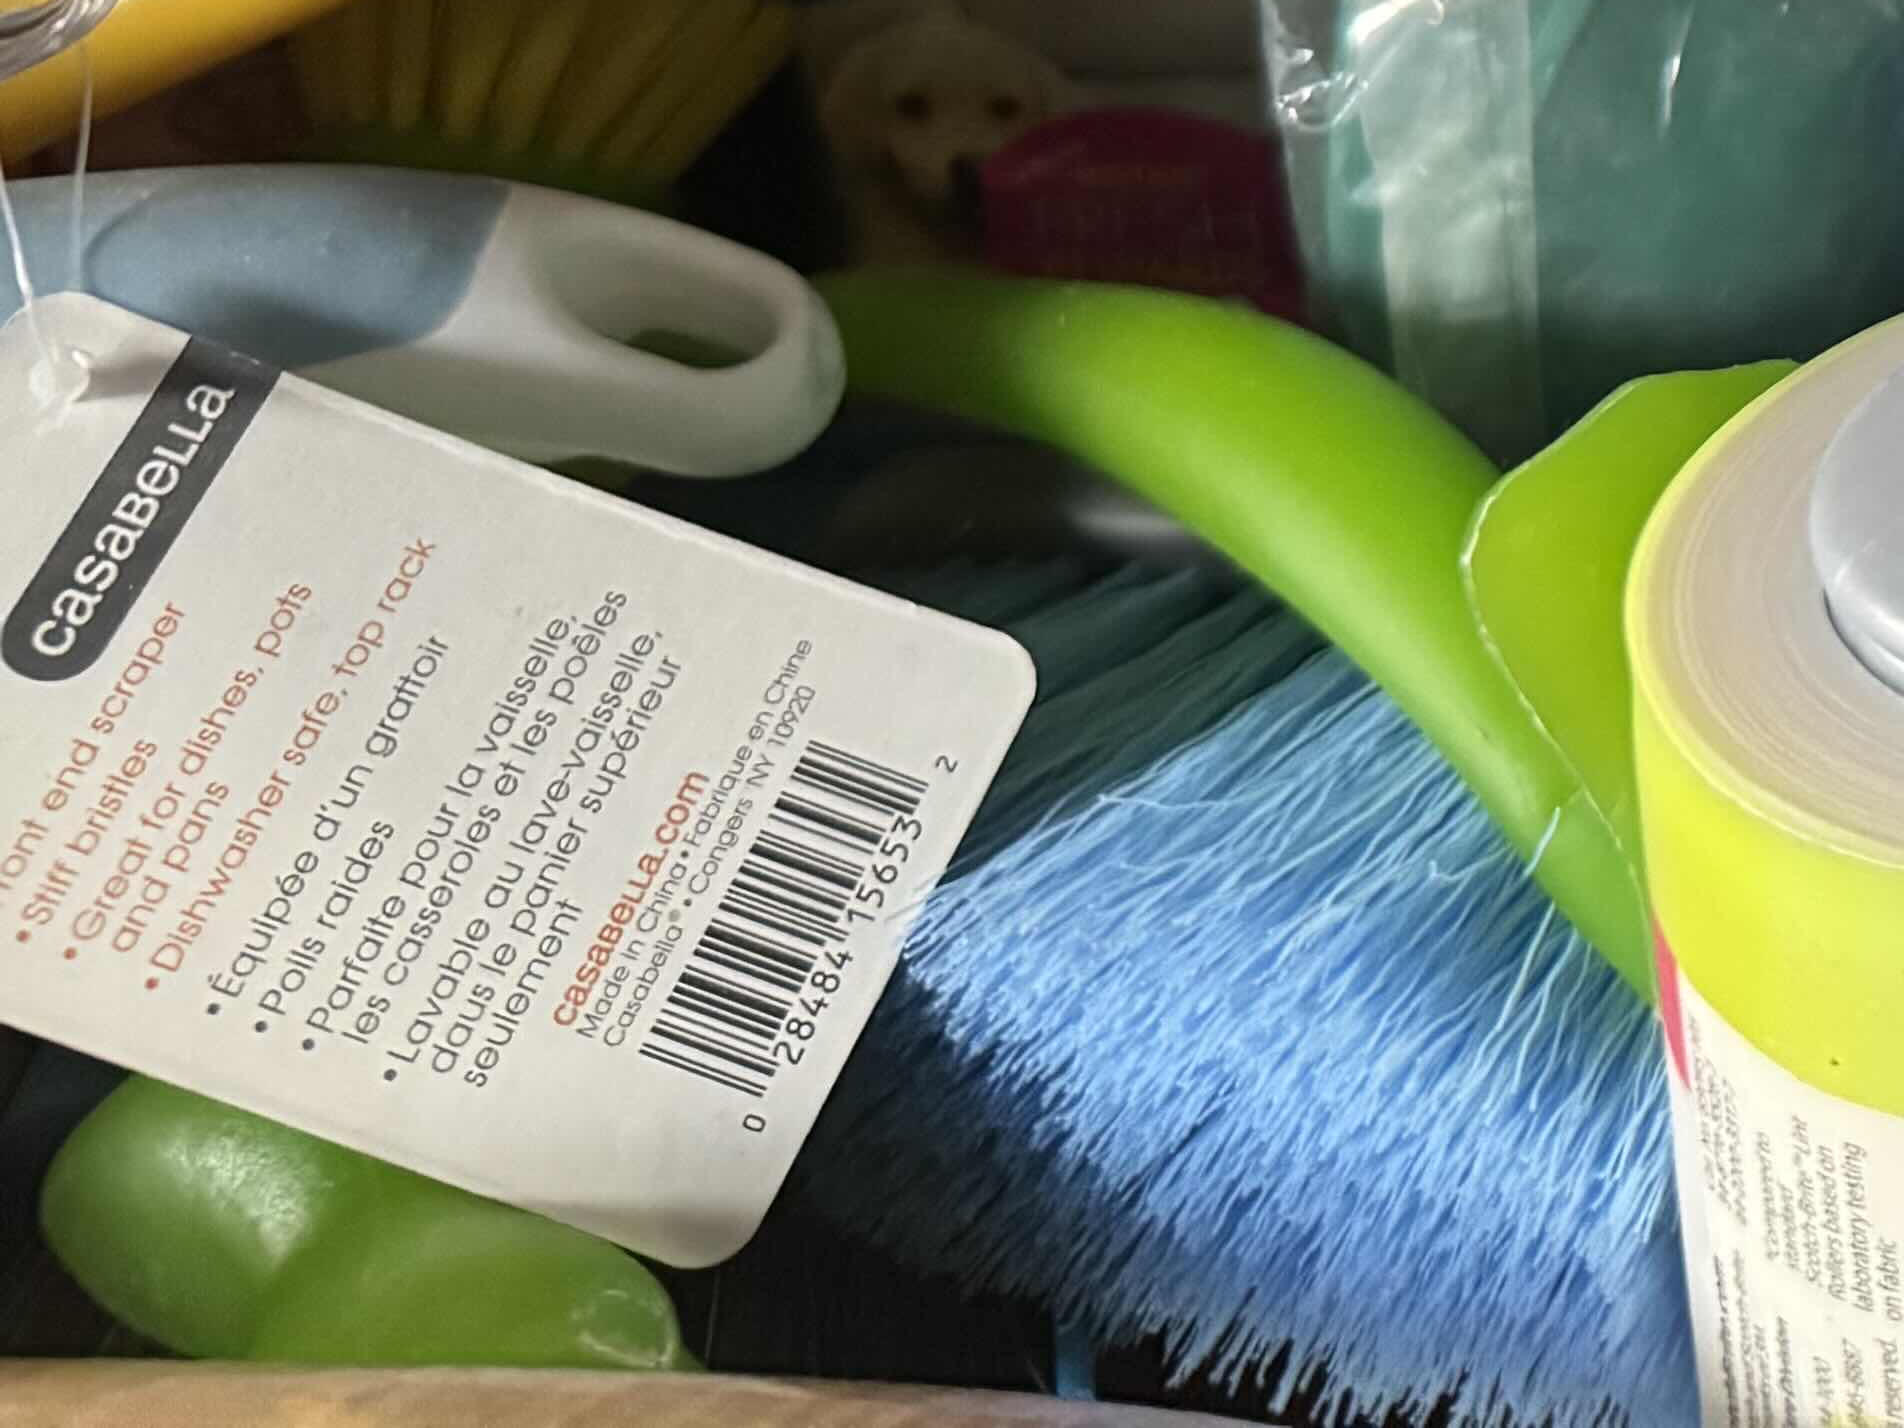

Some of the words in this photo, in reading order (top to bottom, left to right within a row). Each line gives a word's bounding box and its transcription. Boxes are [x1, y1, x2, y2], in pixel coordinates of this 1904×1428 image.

[41, 737, 101, 812] end
[90, 601, 186, 735] scraper
[508, 709, 558, 757] les
[547, 590, 628, 706] poêles
[20, 859, 80, 926] Stiff
[63, 739, 158, 857] bristles
[71, 836, 153, 942] Great
[138, 781, 187, 831] for
[178, 666, 265, 777] dishes,
[252, 583, 313, 659] pots
[148, 769, 292, 973] Dishwasher
[282, 687, 349, 767] safe,
[330, 619, 385, 678] top
[375, 537, 438, 614] rack
[206, 850, 320, 999] Équipée
[364, 634, 449, 759] grattoir
[304, 895, 407, 1034] Parfaite
[397, 802, 460, 891] pour
[443, 762, 487, 798] la
[473, 615, 585, 753] vaisselle,
[385, 917, 491, 1064] Lavable
[483, 860, 526, 910] au
[508, 630, 664, 855] lave-vaisselle,
[477, 942, 518, 977] le
[508, 816, 589, 938] panier
[578, 655, 682, 815] supérieur
[493, 760, 527, 798] et
[575, 965, 631, 1039] Made
[635, 861, 688, 934] China
[674, 744, 766, 848] Fabrique
[747, 711, 775, 742] en
[762, 639, 813, 705] Chine
[687, 798, 753, 895] Congers
[745, 753, 775, 788] NY
[766, 685, 817, 747] 10920
[111, 874, 171, 953] and
[160, 781, 230, 873] pans
[315, 820, 395, 931] raides
[374, 804, 502, 987] casseroles
[741, 1109, 768, 1136] 0
[774, 946, 854, 1065] 28484
[845, 814, 925, 927] 15653
[934, 753, 959, 775] 2
[340, 994, 392, 1045] les
[448, 898, 584, 1089] seulement
[1819, 1145, 1834, 1170] on
[1844, 1142, 1866, 1205] testing
[1849, 1212, 1871, 1310] laboratory
[1878, 1237, 1898, 1291] fabric
[1887, 1295, 1901, 1319] on
